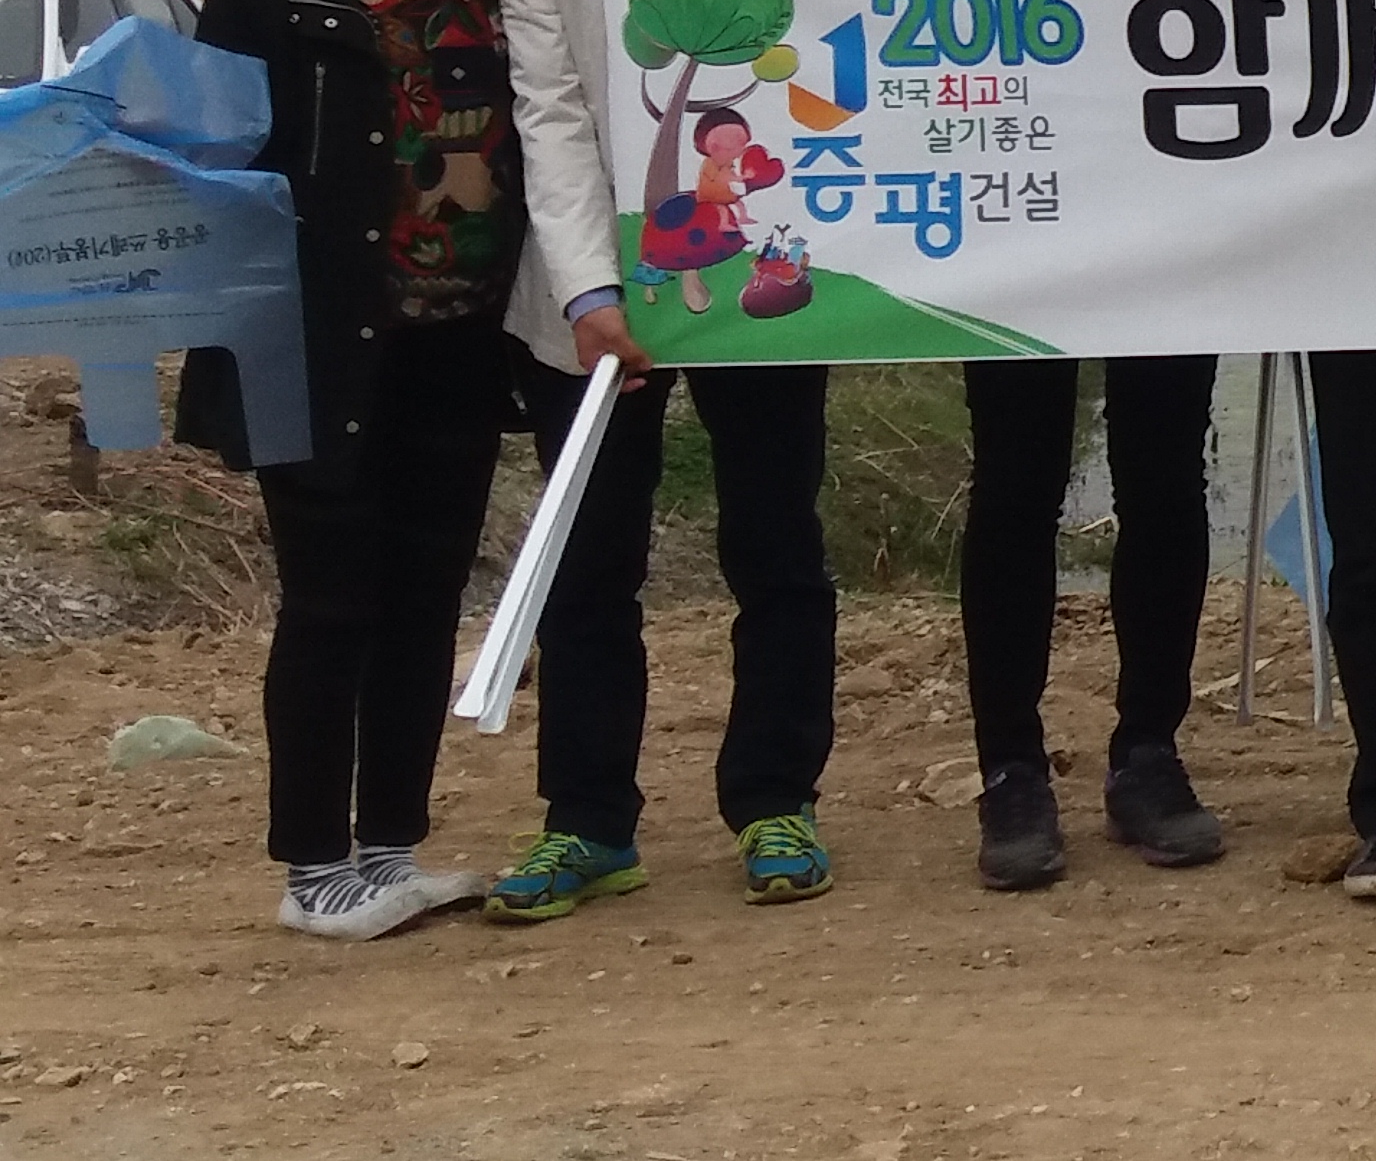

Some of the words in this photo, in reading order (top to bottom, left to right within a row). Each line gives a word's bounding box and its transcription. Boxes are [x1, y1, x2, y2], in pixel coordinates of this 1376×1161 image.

[878, 77, 931, 109] 전국
[936, 74, 1029, 112] 최고의
[791, 134, 962, 259] 증평
[969, 171, 1060, 223] 건설
